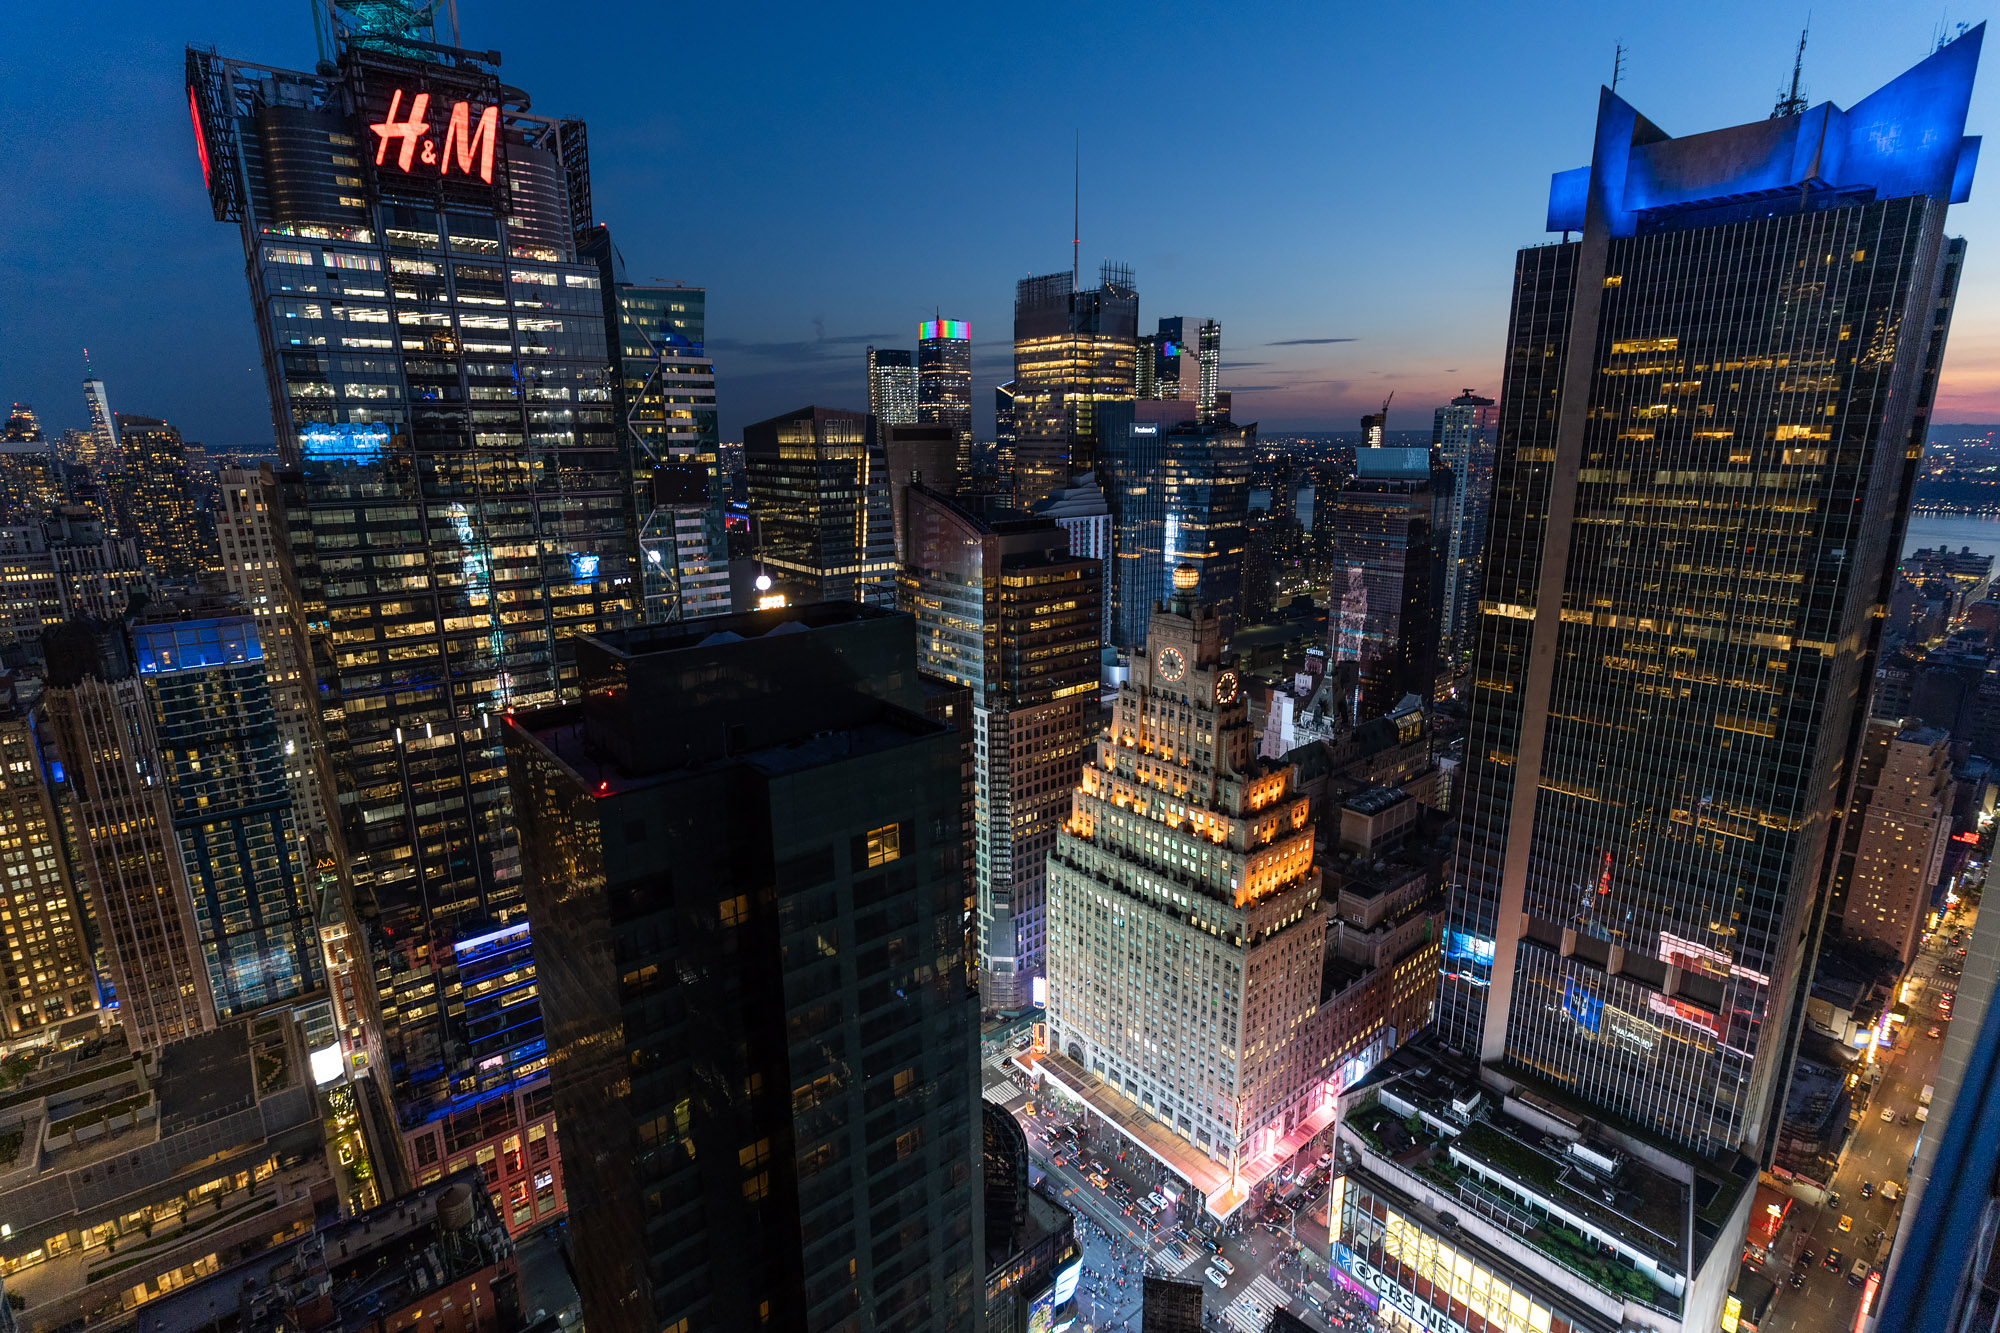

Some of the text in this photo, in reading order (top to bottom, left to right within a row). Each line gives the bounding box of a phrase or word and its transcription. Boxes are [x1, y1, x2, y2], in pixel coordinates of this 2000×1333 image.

[369, 88, 499, 185] H&M
[1373, 1274, 1416, 1313] CBS
[1482, 1280, 1509, 1303] THE
[1496, 1302, 1538, 1333] KIN
